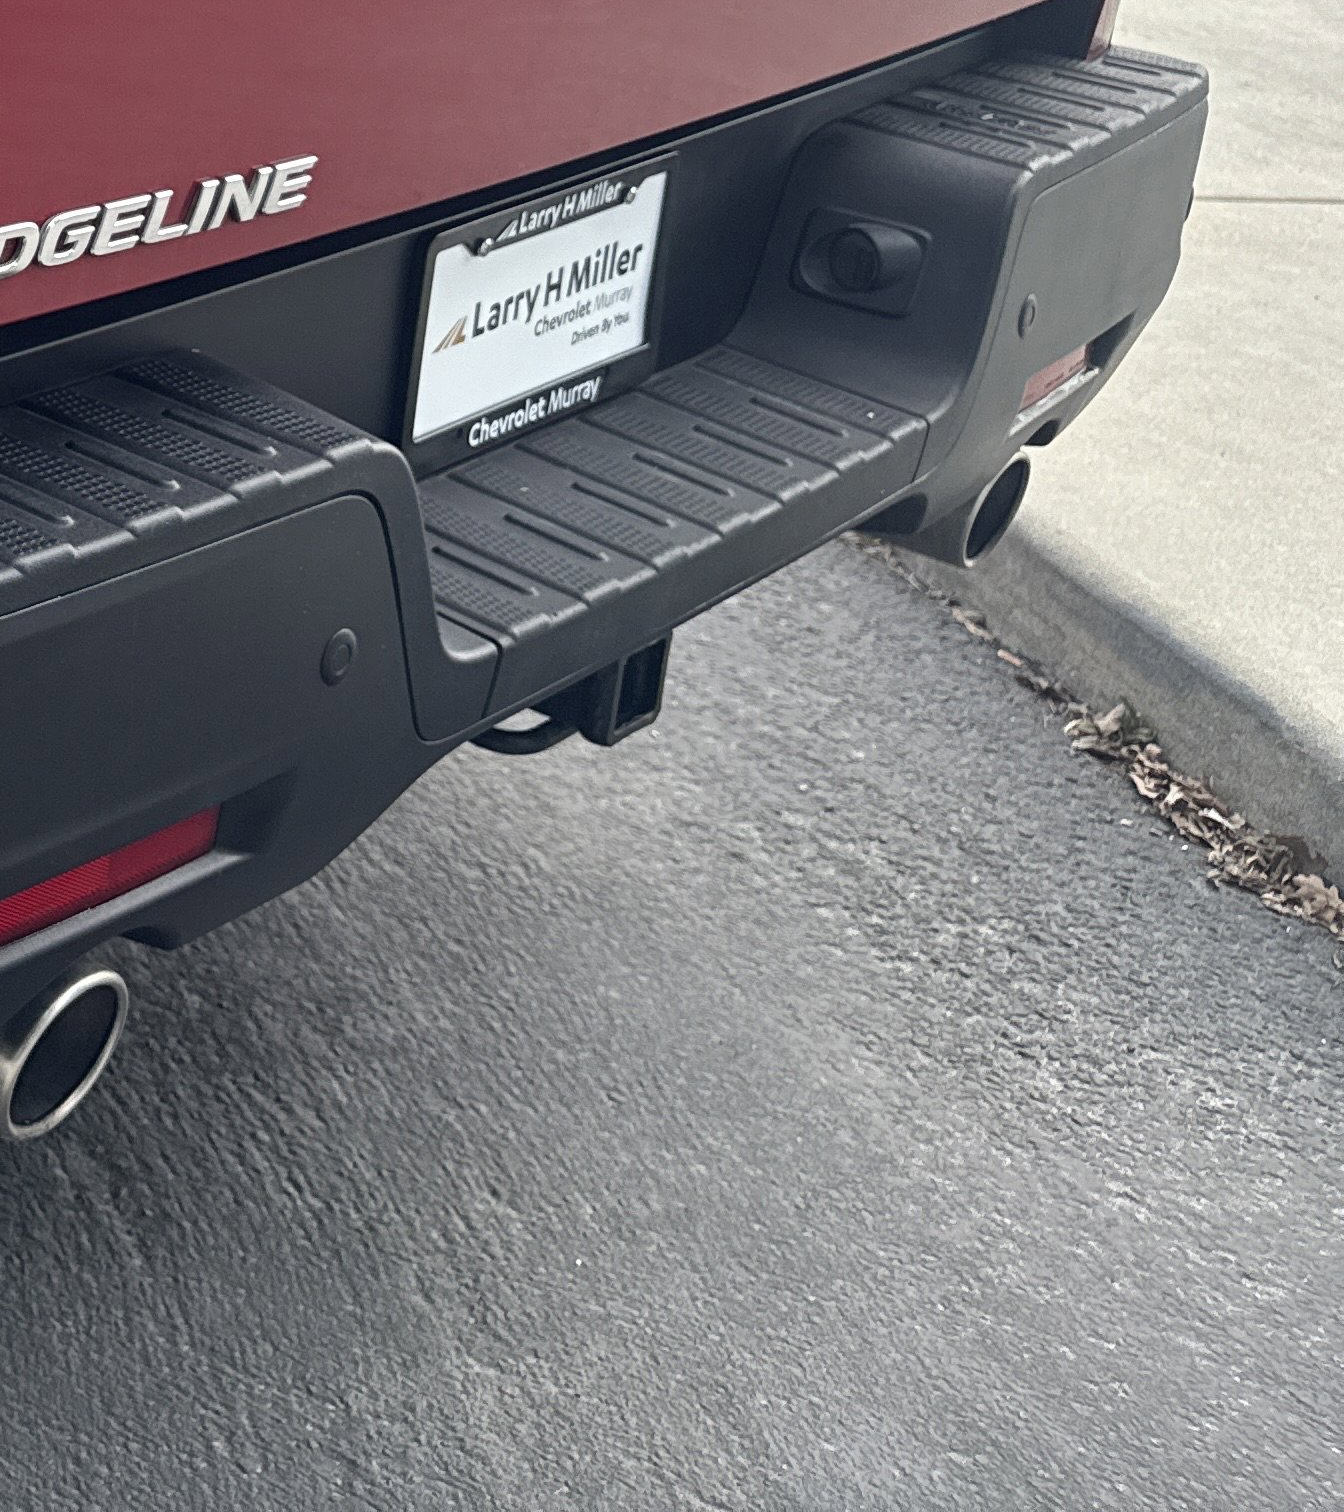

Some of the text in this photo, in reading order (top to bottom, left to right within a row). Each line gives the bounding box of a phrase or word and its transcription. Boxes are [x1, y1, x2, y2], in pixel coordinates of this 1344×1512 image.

[519, 180, 624, 234] Larry H Miller
[472, 240, 643, 338] Larry H Miller
[534, 285, 633, 336] Chevrolet Murray
[468, 376, 601, 447] Chevrolet Murray
